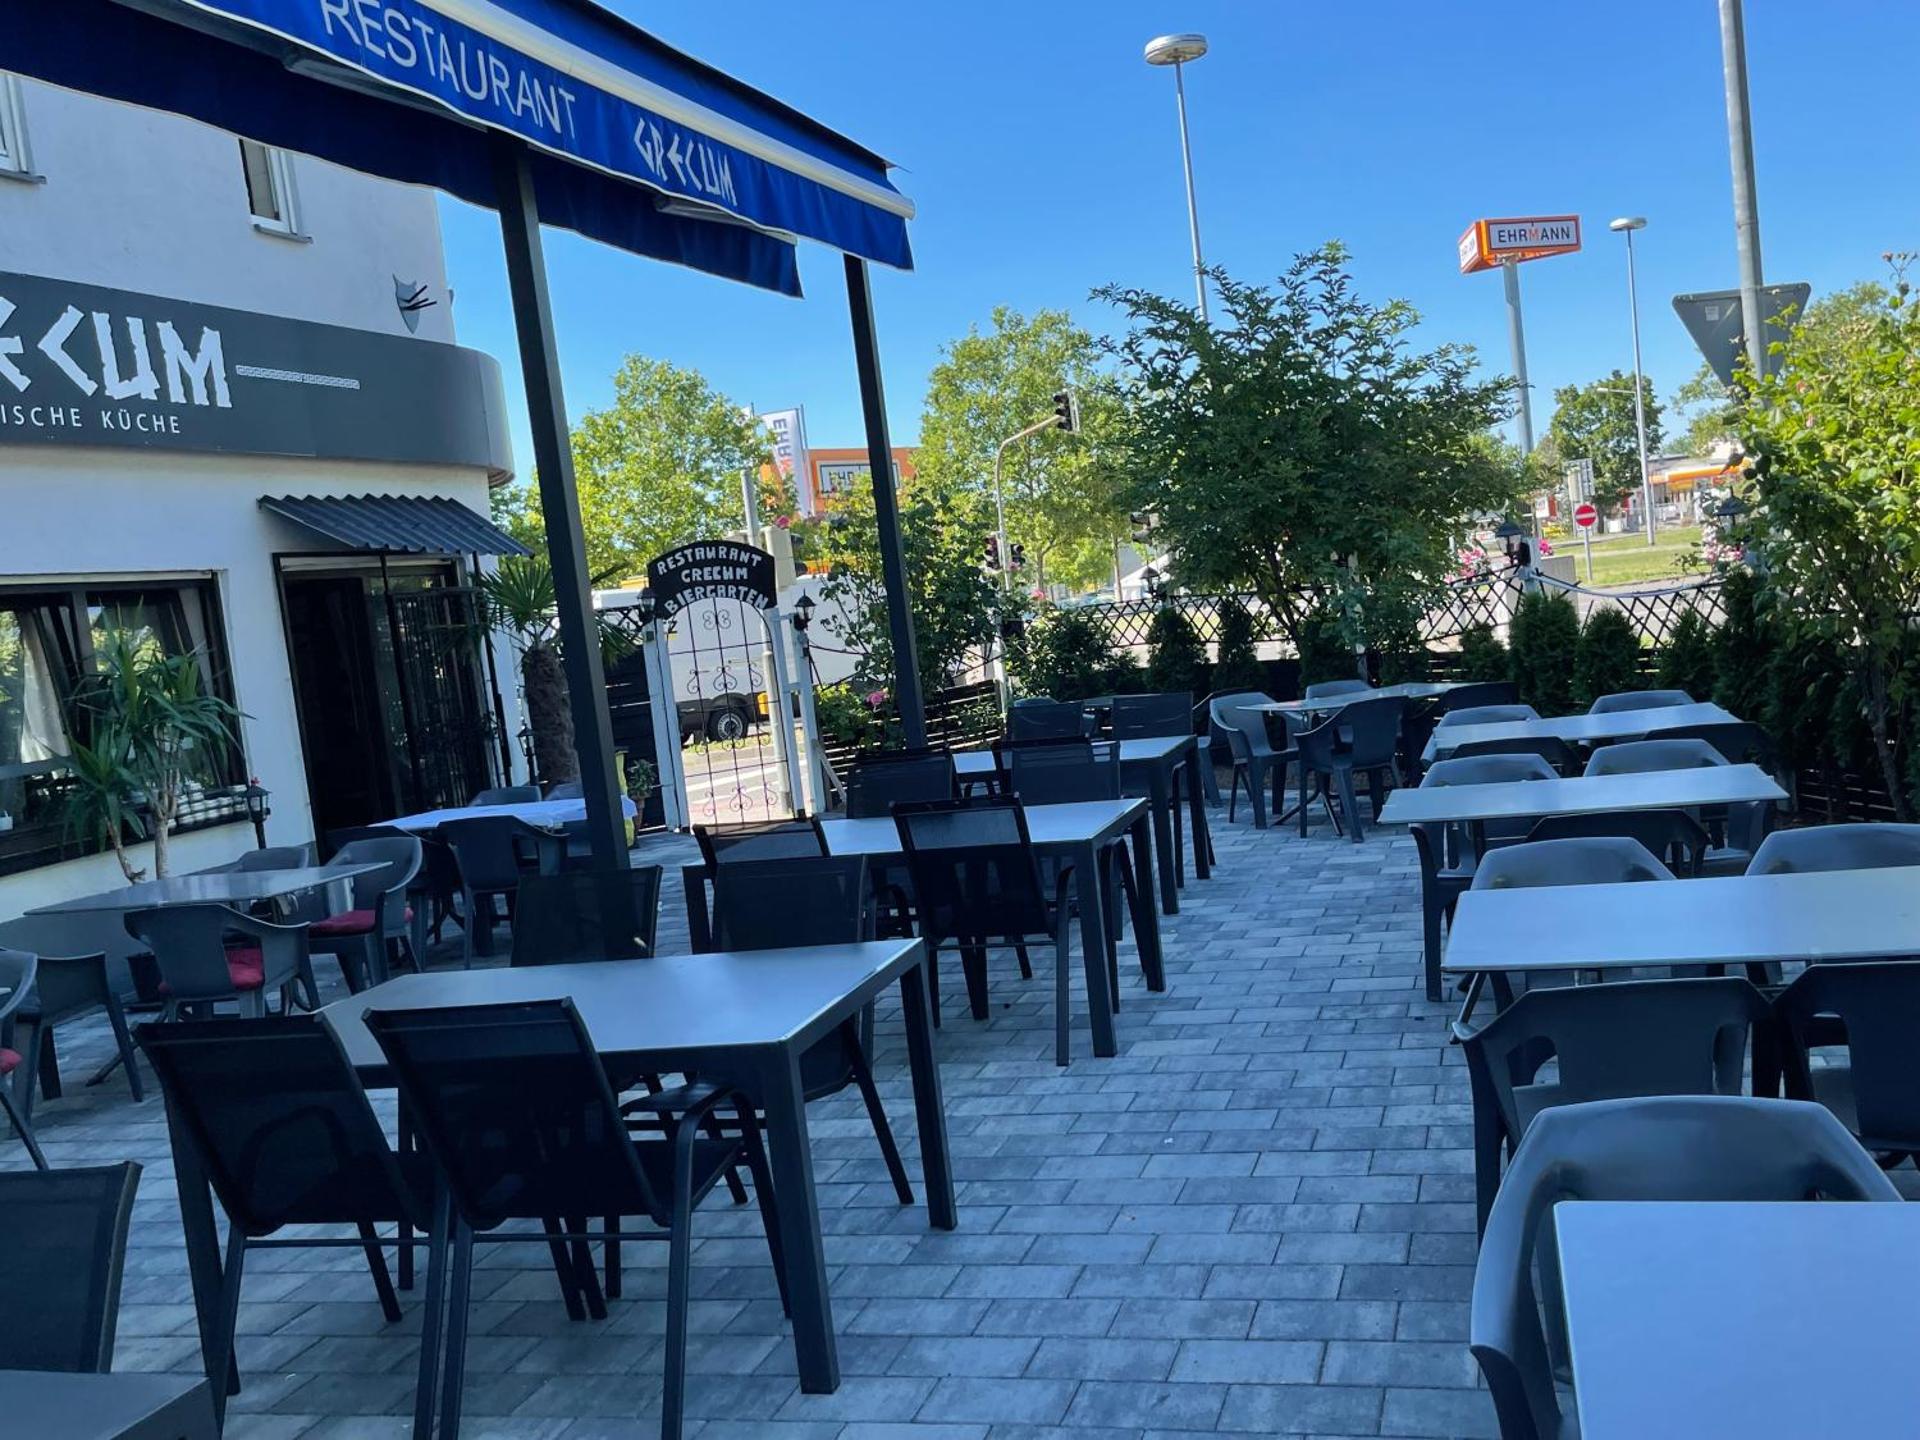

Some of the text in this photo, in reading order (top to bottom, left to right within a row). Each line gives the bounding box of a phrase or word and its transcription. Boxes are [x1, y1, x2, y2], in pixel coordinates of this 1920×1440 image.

[321, 0, 737, 206] RESTAURANT GRECUM
[1498, 226, 1570, 243] EHRMANN
[101, 409, 181, 435] KÜCHE
[656, 545, 762, 576] RESTAURANT
[664, 584, 769, 614] BIERGARTEN
